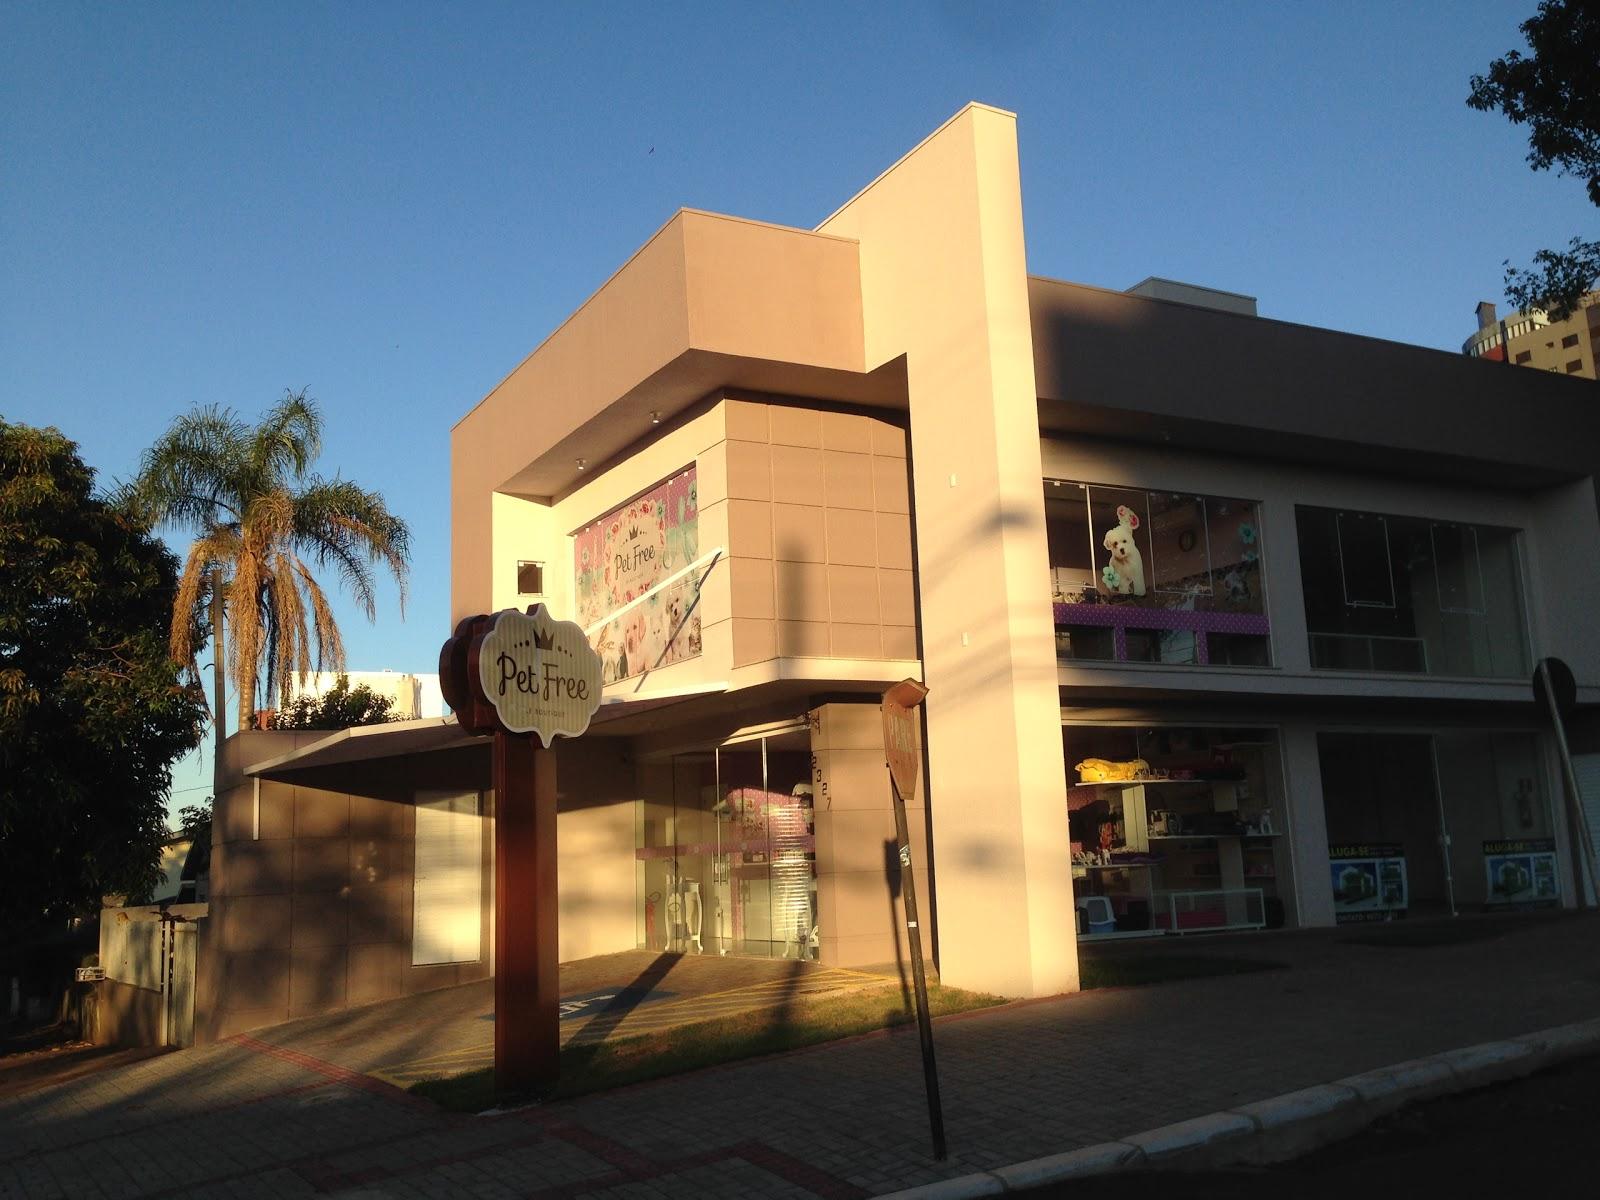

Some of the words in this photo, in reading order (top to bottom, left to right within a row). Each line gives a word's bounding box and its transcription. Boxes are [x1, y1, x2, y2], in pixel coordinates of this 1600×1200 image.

[614, 554, 632, 581] Pet
[633, 544, 656, 572] Free
[497, 652, 539, 697] Pet
[542, 662, 590, 702] Free
